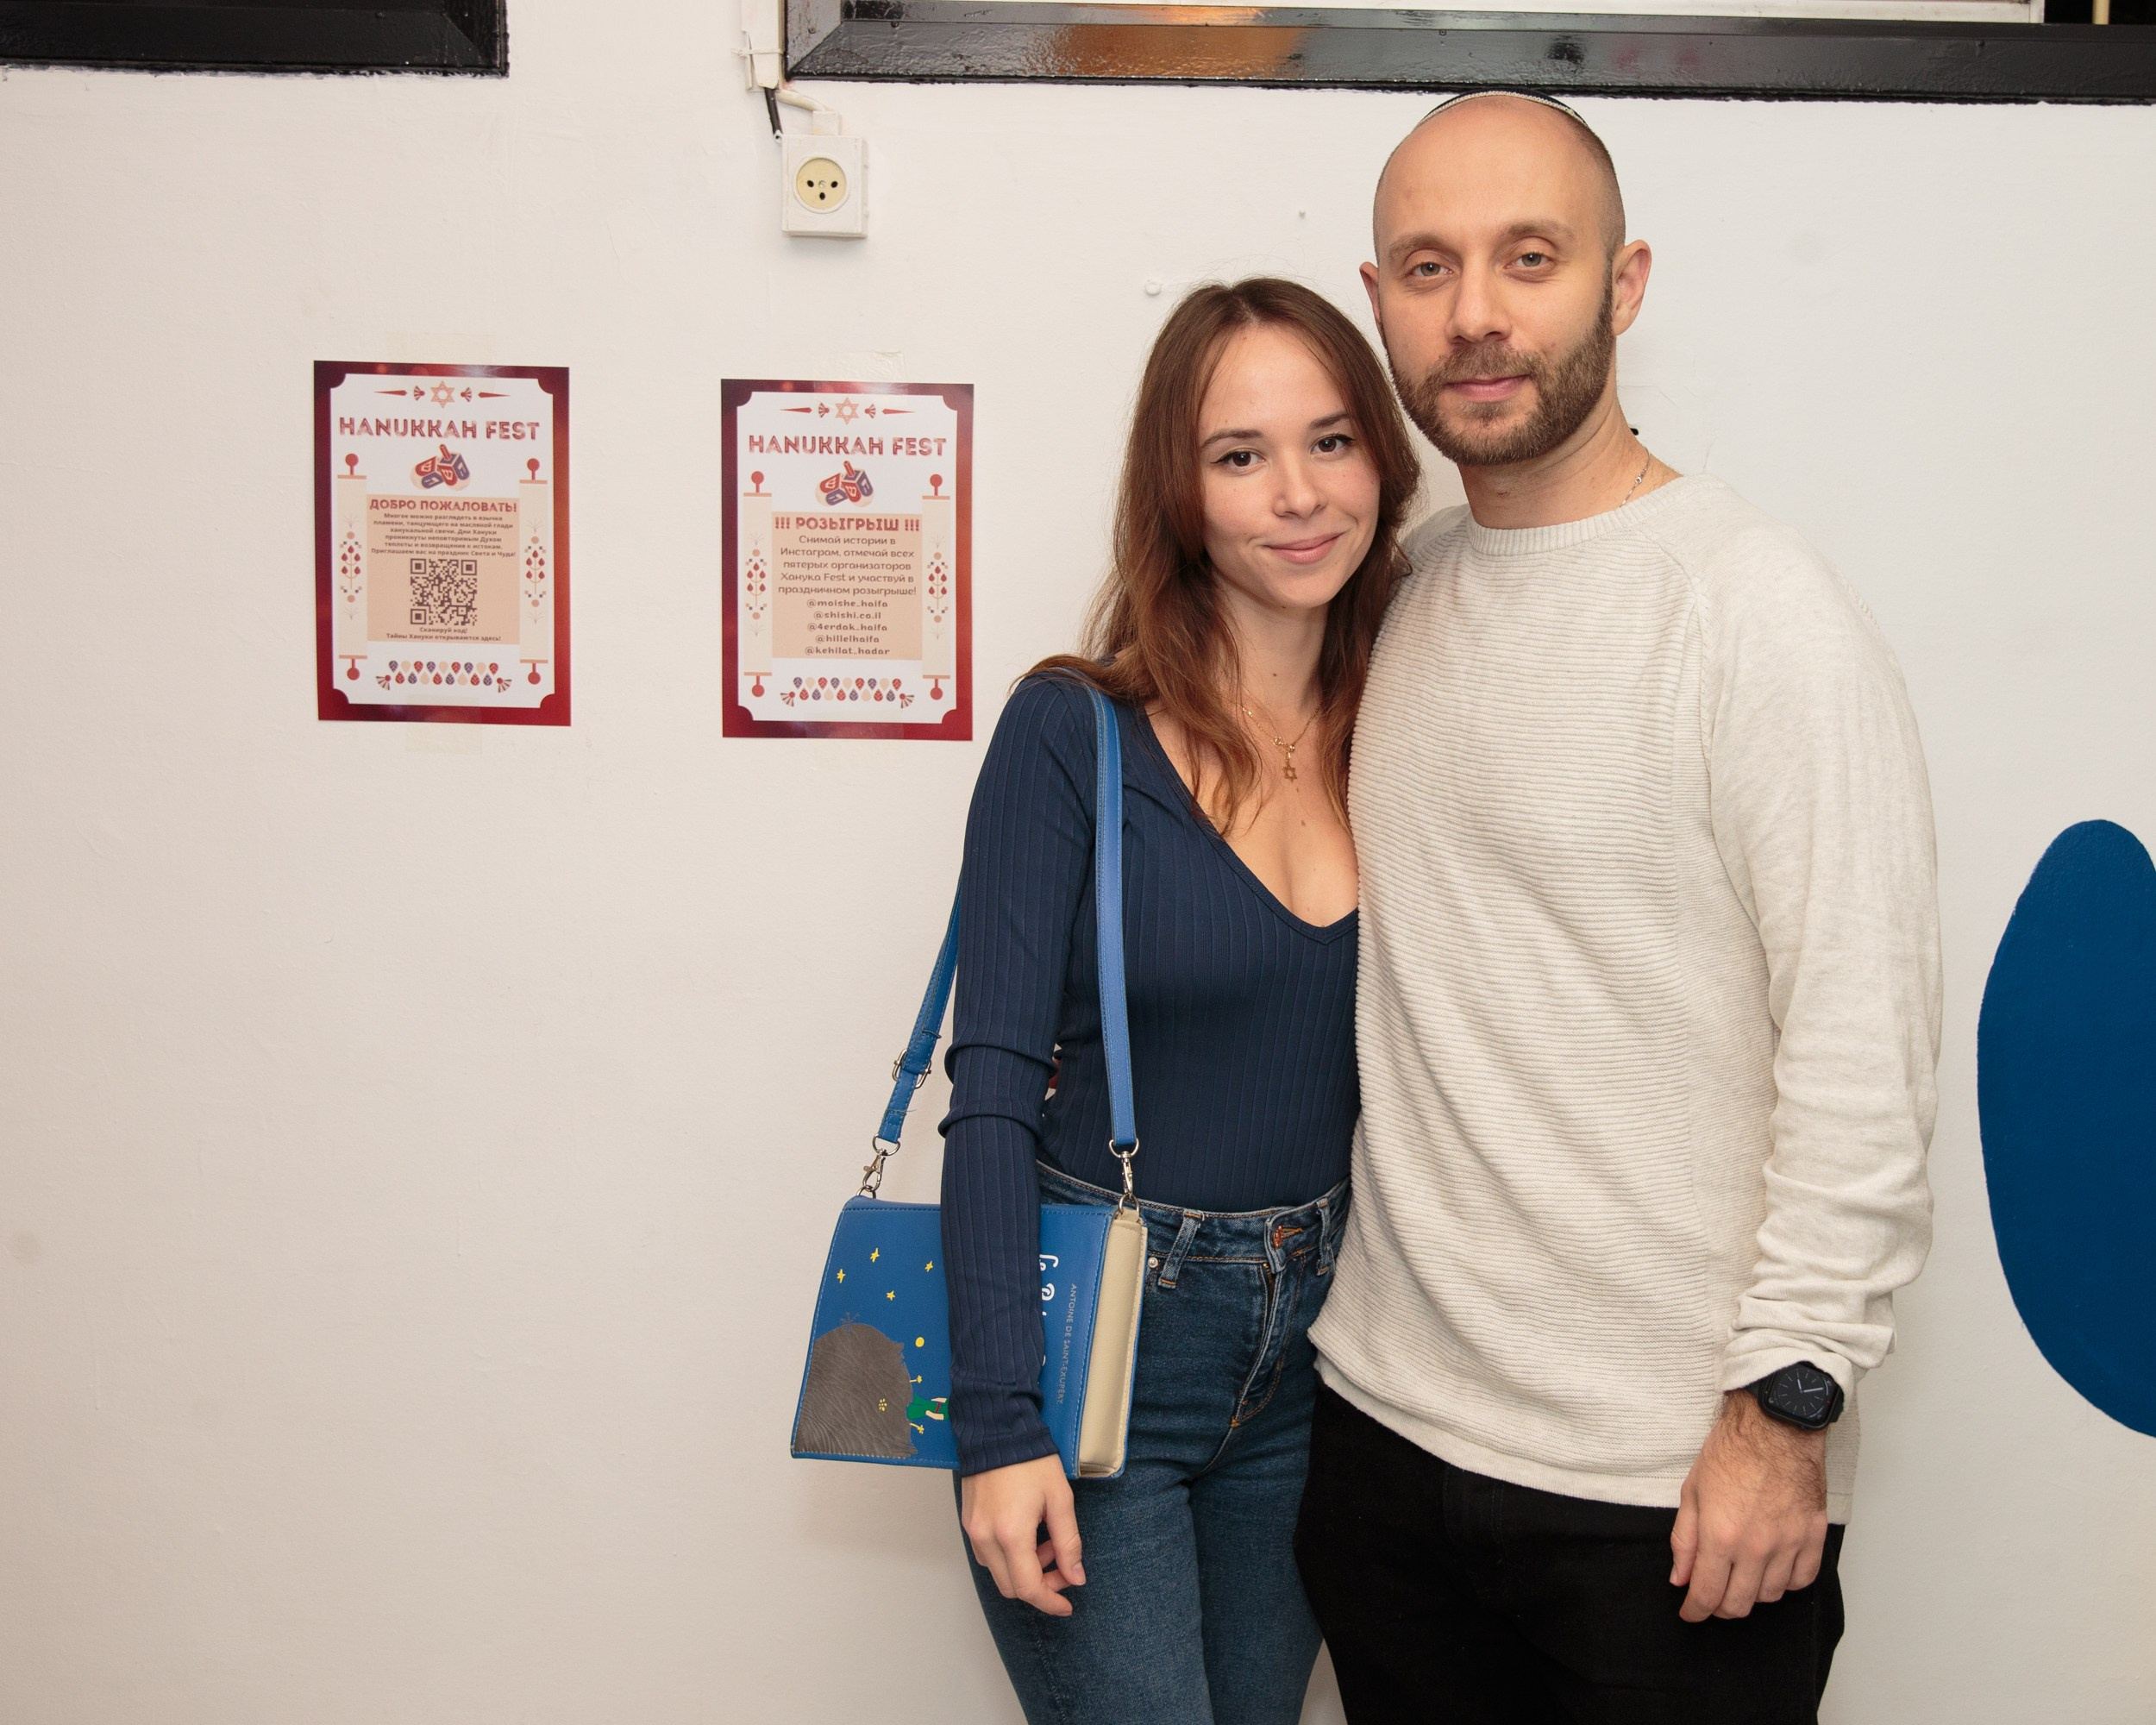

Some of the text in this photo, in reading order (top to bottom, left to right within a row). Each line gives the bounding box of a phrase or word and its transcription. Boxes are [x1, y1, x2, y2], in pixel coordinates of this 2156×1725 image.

[339, 417, 541, 441] HANUKKAH FEST
[749, 435, 947, 456] HANUKKAH FEST
[369, 499, 517, 512] ДОБРО ПОЖАЛОВАТЬ!
[774, 517, 920, 531] !!! РОЗЫГРЫШ !!!
[799, 535, 841, 544] Снимай
[843, 536, 887, 547] истории
[783, 561, 912, 573] пятерых организаторов
[780, 573, 821, 584] Ханука
[824, 573, 846, 581] Fest
[857, 574, 906, 584] участвуй
[778, 586, 917, 597] праздничном розыгрыше!
[806, 599, 888, 608] @moishe_haifa
[813, 611, 881, 620] @shishi.co.il
[807, 623, 888, 632] @4erdak_haifa
[816, 634, 880, 643] @hillelhaifa
[805, 646, 891, 656] @kehilat_hadar
[1066, 1283, 1077, 1323] ANTOINE
[1064, 1326, 1073, 1337] DE
